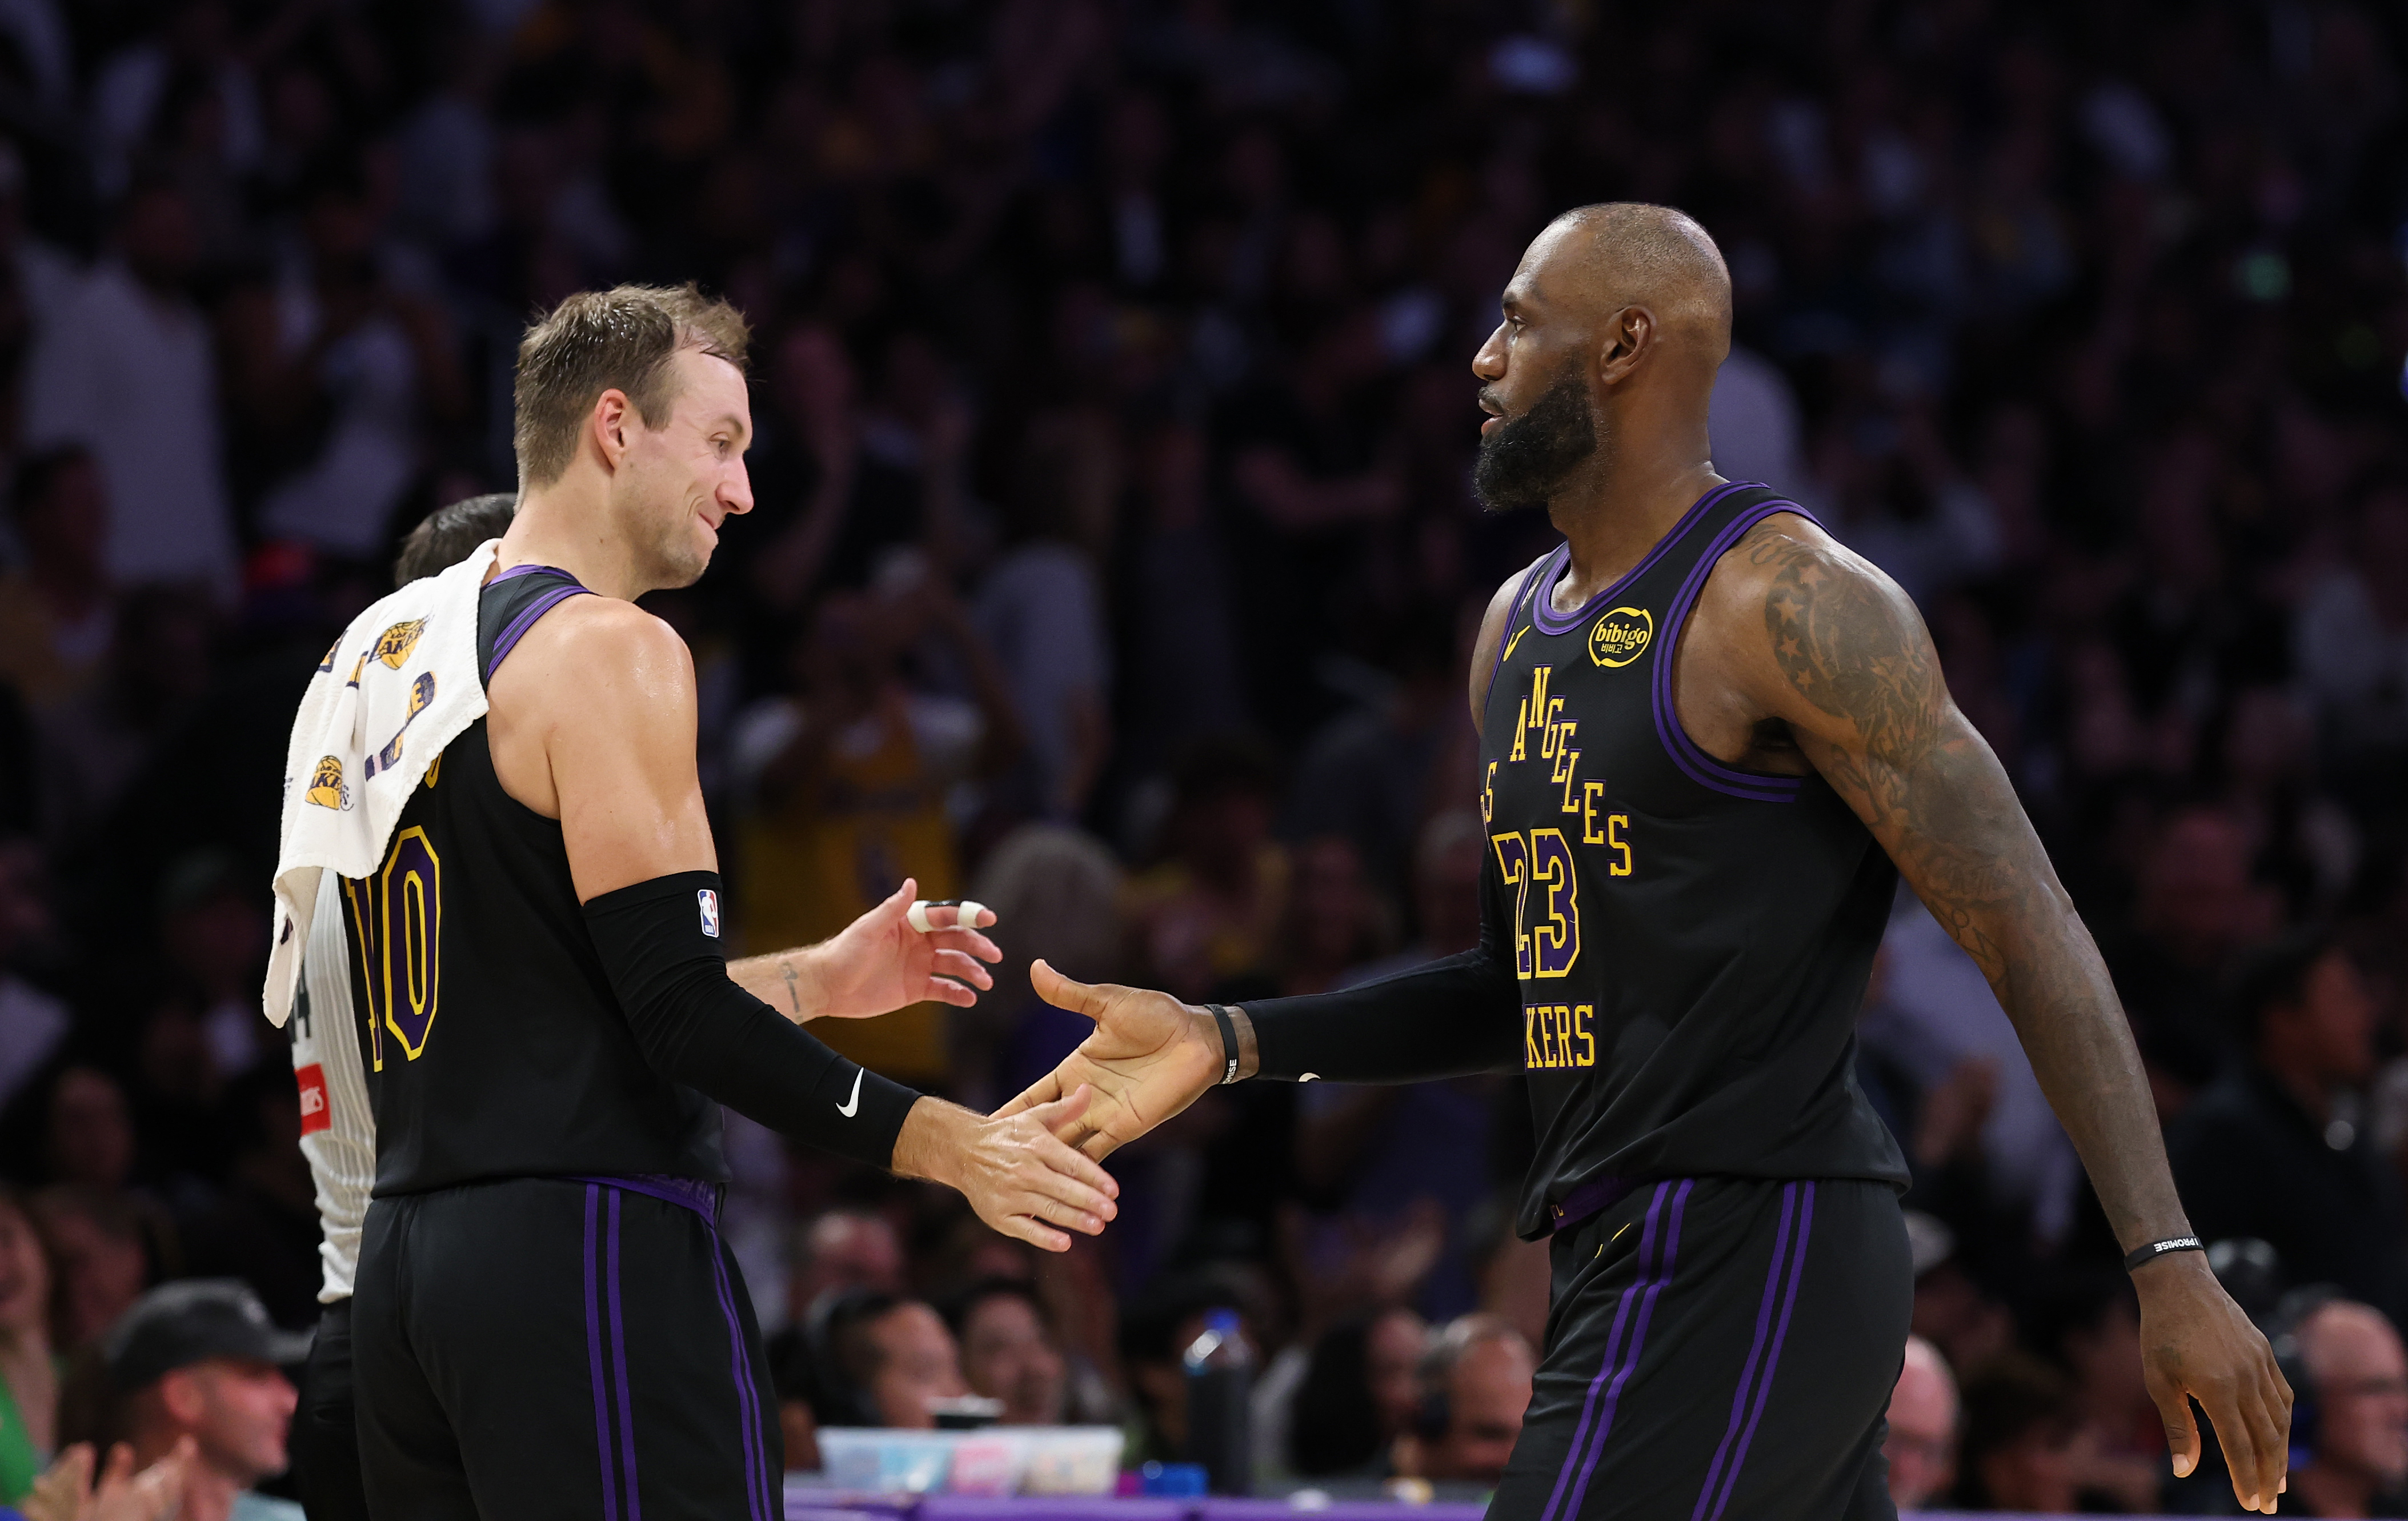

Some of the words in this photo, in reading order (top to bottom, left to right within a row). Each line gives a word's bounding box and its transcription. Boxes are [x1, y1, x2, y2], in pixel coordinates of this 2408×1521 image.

[1595, 622, 1648, 650] bibigo
[1601, 643, 1623, 654] 비비고
[1509, 664, 1634, 879] ANGELES
[1492, 828, 1580, 979] 23
[345, 825, 440, 1072] 10
[2153, 1238, 2195, 1252] PROMISE
